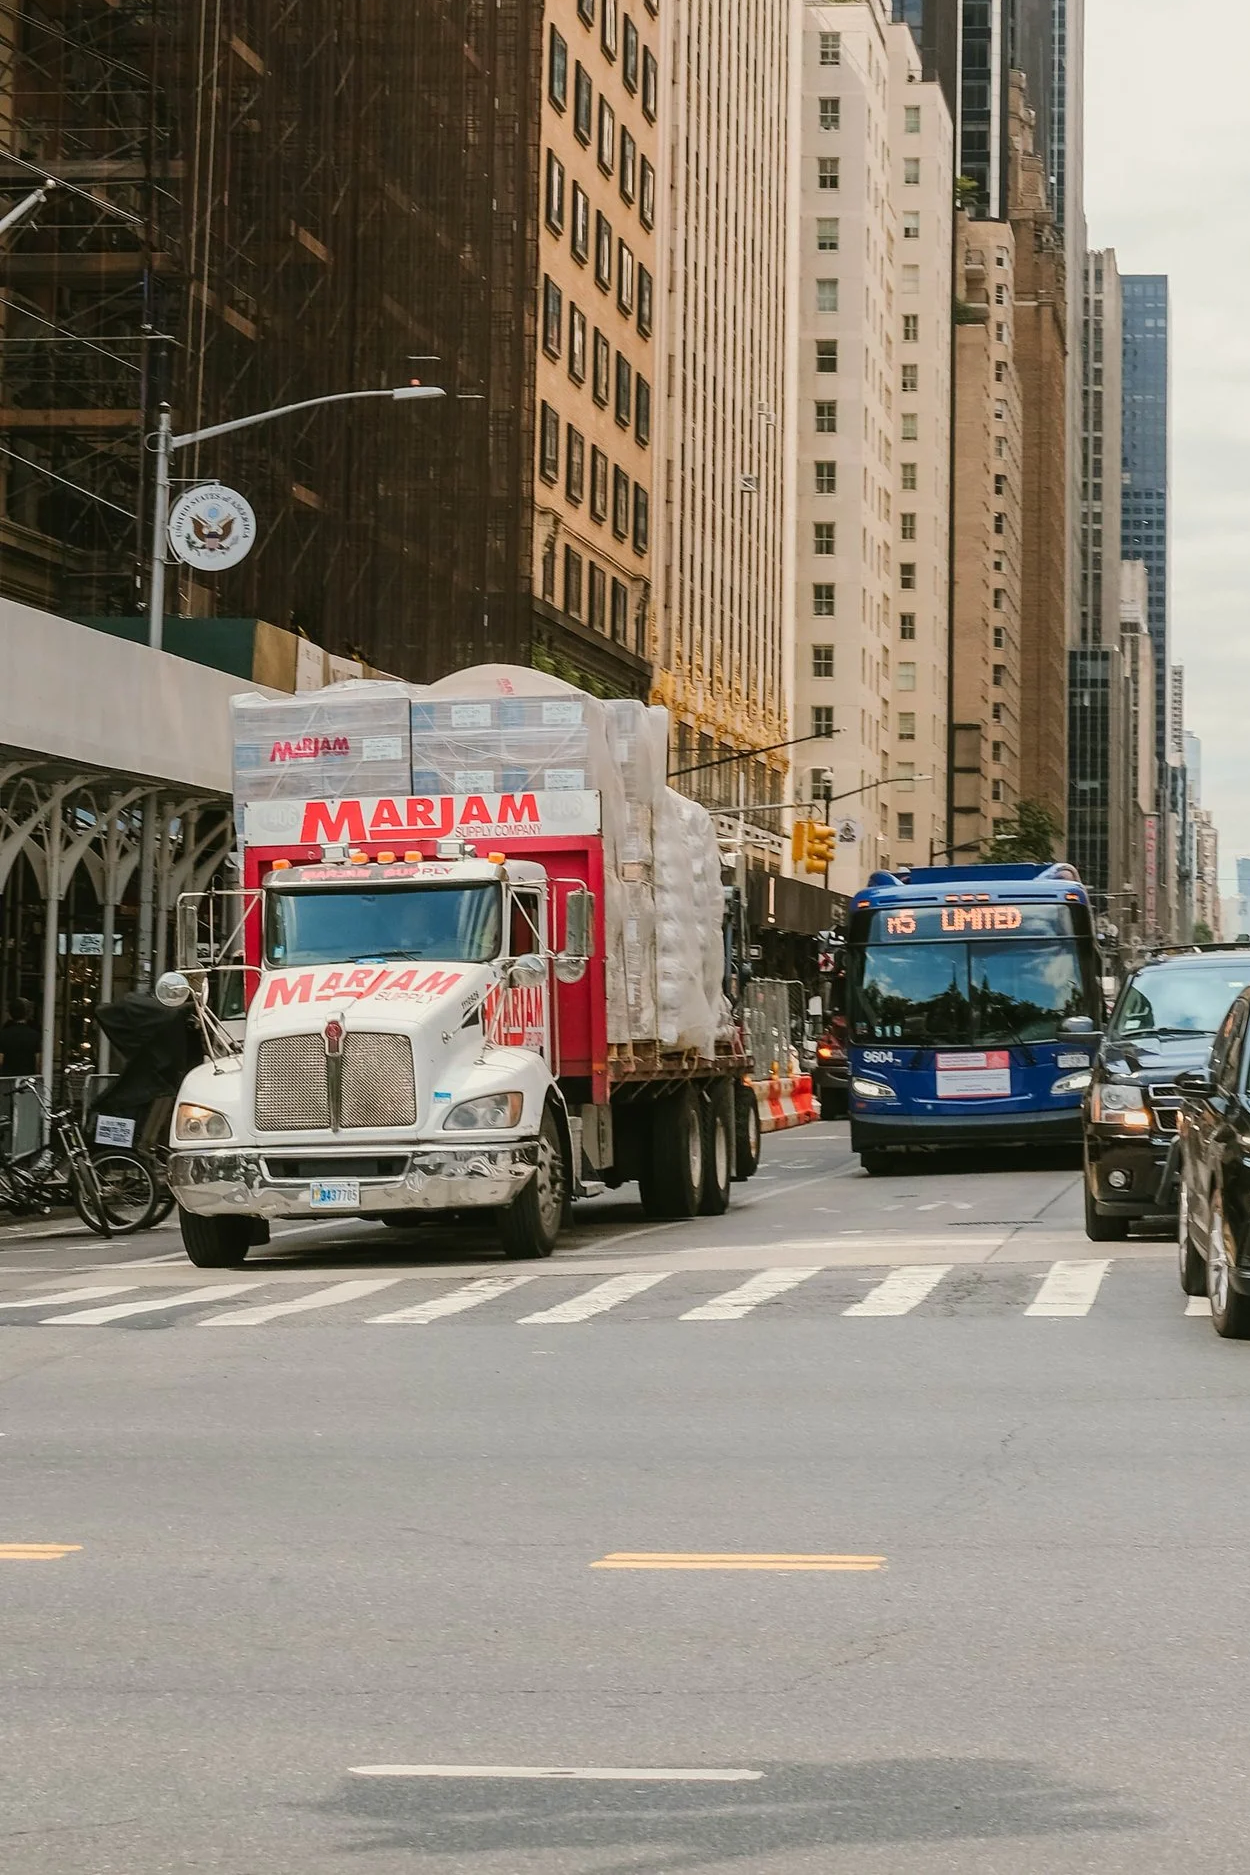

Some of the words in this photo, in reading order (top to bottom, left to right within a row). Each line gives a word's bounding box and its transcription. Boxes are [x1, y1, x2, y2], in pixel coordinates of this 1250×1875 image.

[270, 736, 350, 762] MARJAM
[300, 794, 540, 843] MARJAM
[455, 825, 492, 838] SUPPLY
[494, 824, 542, 837] COMPANY
[941, 906, 1022, 931] LIMITED
[263, 968, 464, 1009] MARJAM
[374, 989, 441, 1005] SUPPLY
[863, 1051, 893, 1063] 9604
